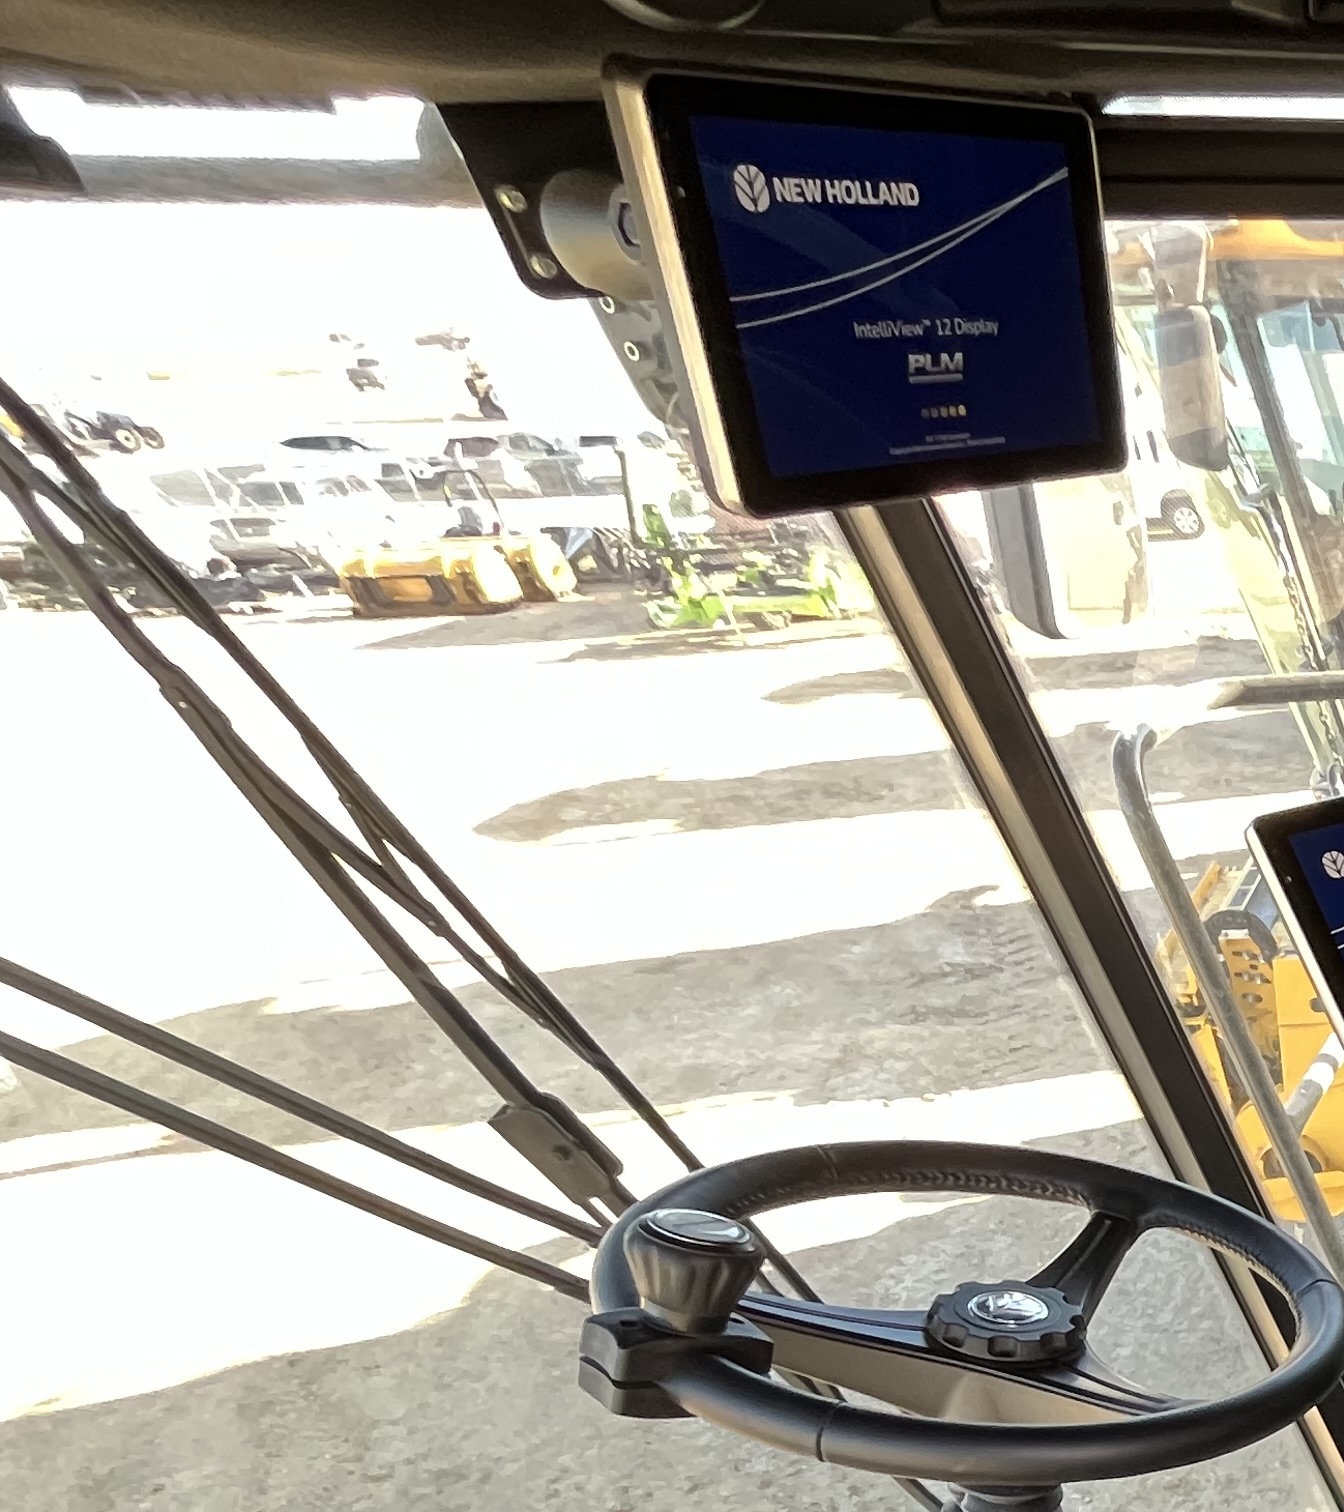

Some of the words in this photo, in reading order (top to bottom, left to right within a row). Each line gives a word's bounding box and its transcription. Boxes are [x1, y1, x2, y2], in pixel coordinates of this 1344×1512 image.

[772, 177, 822, 204] NEW
[824, 179, 920, 206] HOLLAND
[936, 318, 953, 336] 12
[954, 317, 999, 336] Display
[908, 352, 964, 373] PLM
